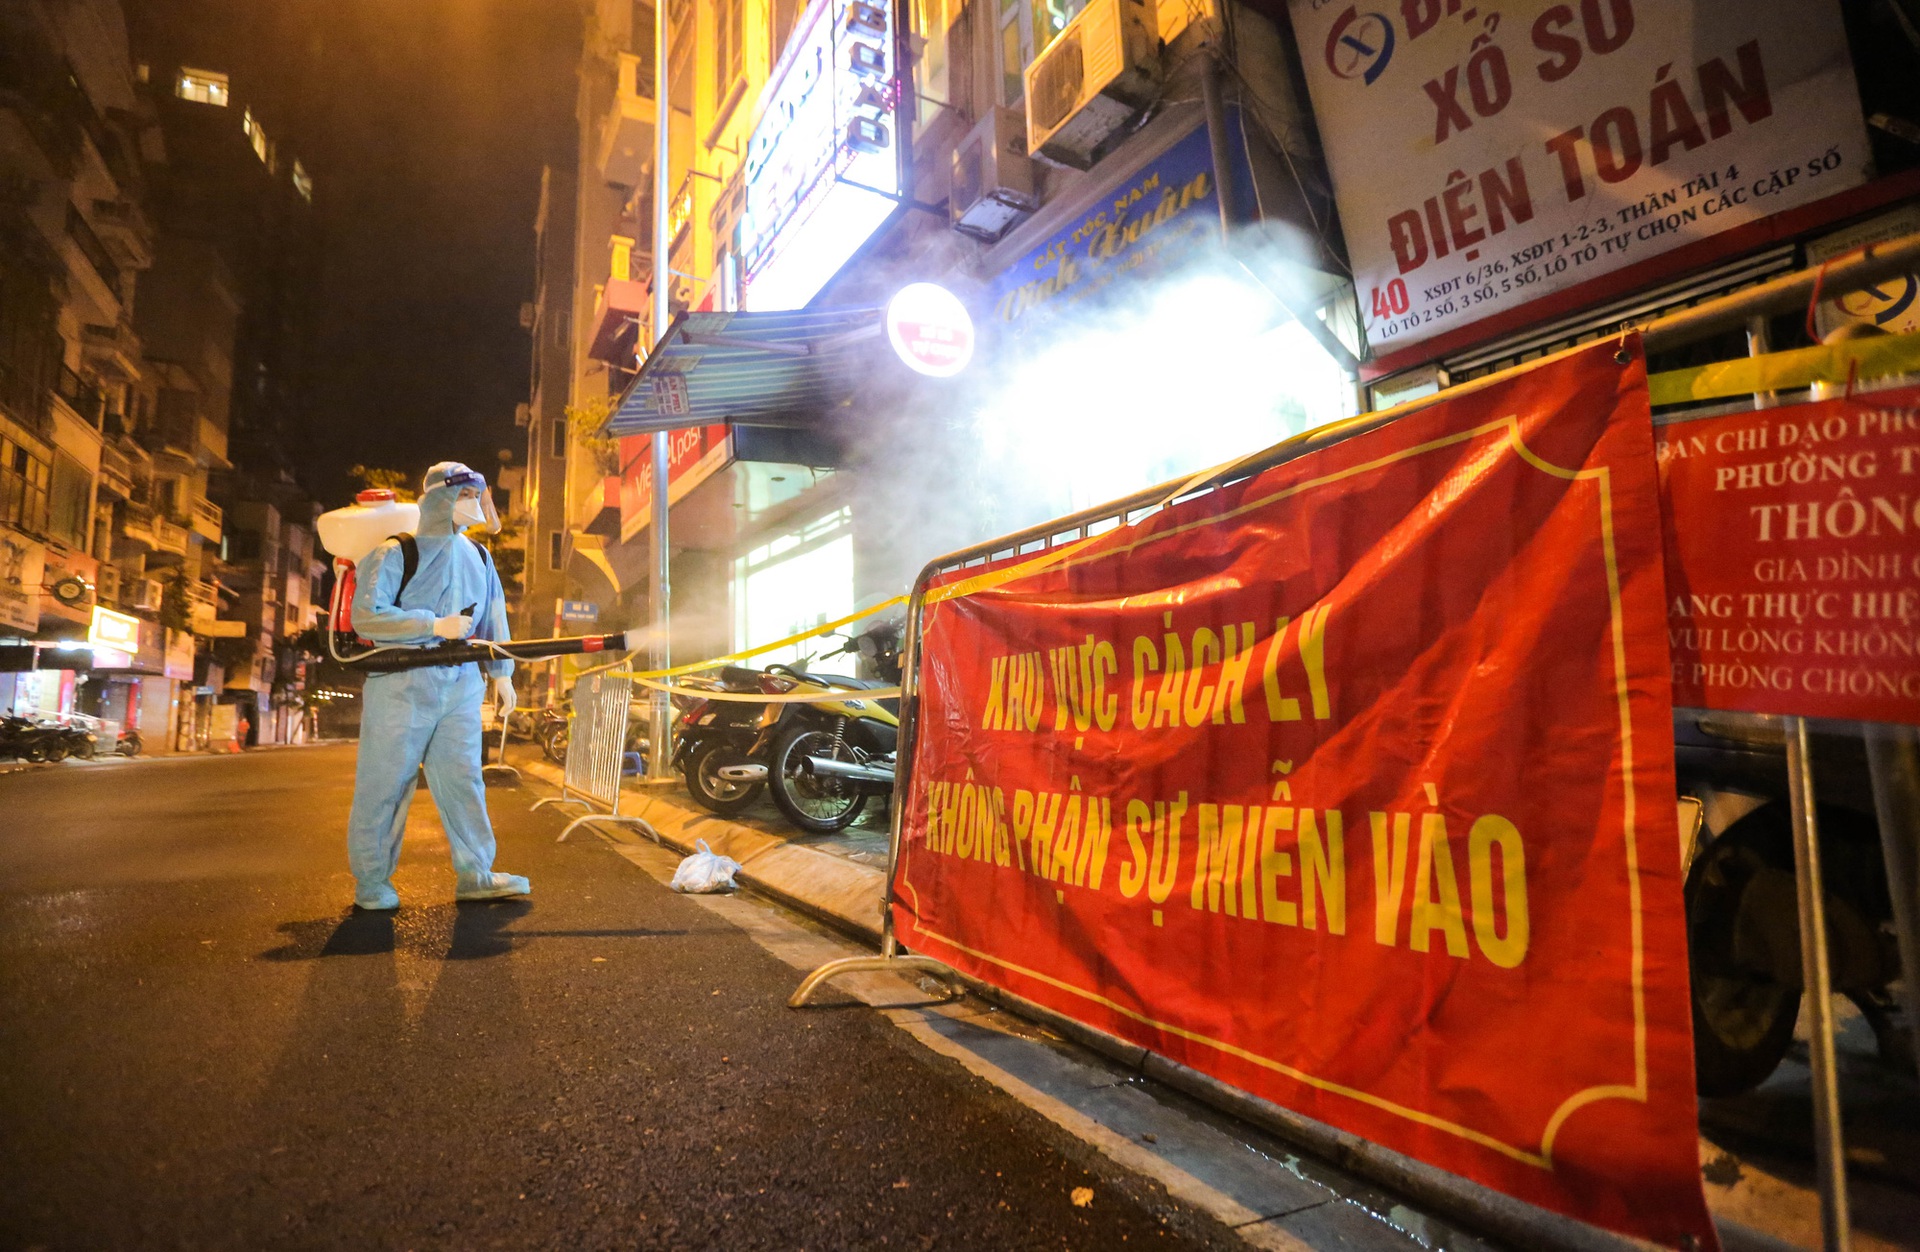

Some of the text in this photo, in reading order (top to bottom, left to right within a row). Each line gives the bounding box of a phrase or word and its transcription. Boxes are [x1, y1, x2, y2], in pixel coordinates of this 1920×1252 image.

[1422, 12, 1512, 146] XỔ
[1386, 38, 1773, 276] ĐIỆN TOÁN
[1114, 172, 1160, 214] NAM
[1424, 276, 1461, 302] XSĐT
[1466, 261, 1509, 286] 6/36,
[1511, 239, 1556, 268] XSĐT
[1561, 217, 1615, 248] 1-2-3,
[1681, 171, 1719, 199] TÀI
[1725, 164, 1740, 181] 4
[1381, 315, 1399, 339] LÔ
[1400, 311, 1420, 331] TÔ
[1424, 309, 1433, 322] 2
[1461, 295, 1471, 309] 3
[1501, 279, 1512, 293] 5
[1545, 255, 1567, 277] LÔ
[1571, 243, 1597, 266] TÔ
[1601, 231, 1631, 255] TỰ
[1637, 206, 1697, 241] CHỌN
[1703, 187, 1748, 217] CÁC
[1372, 278, 1410, 320] 40
[1714, 451, 1878, 492] PHƯỜNG
[1751, 486, 1920, 542] THÔN
[1754, 558, 1809, 582] GIA
[1668, 594, 1733, 619] ANG
[1721, 622, 1804, 654] LÒNG
[1814, 623, 1920, 657] KHÔN
[981, 603, 1333, 750] KHU VỰC CÁCH LY
[1692, 657, 1793, 691] PHÒNG
[926, 758, 1530, 969] KHÔNG PHẬN SỰ MIỄN VÀO
